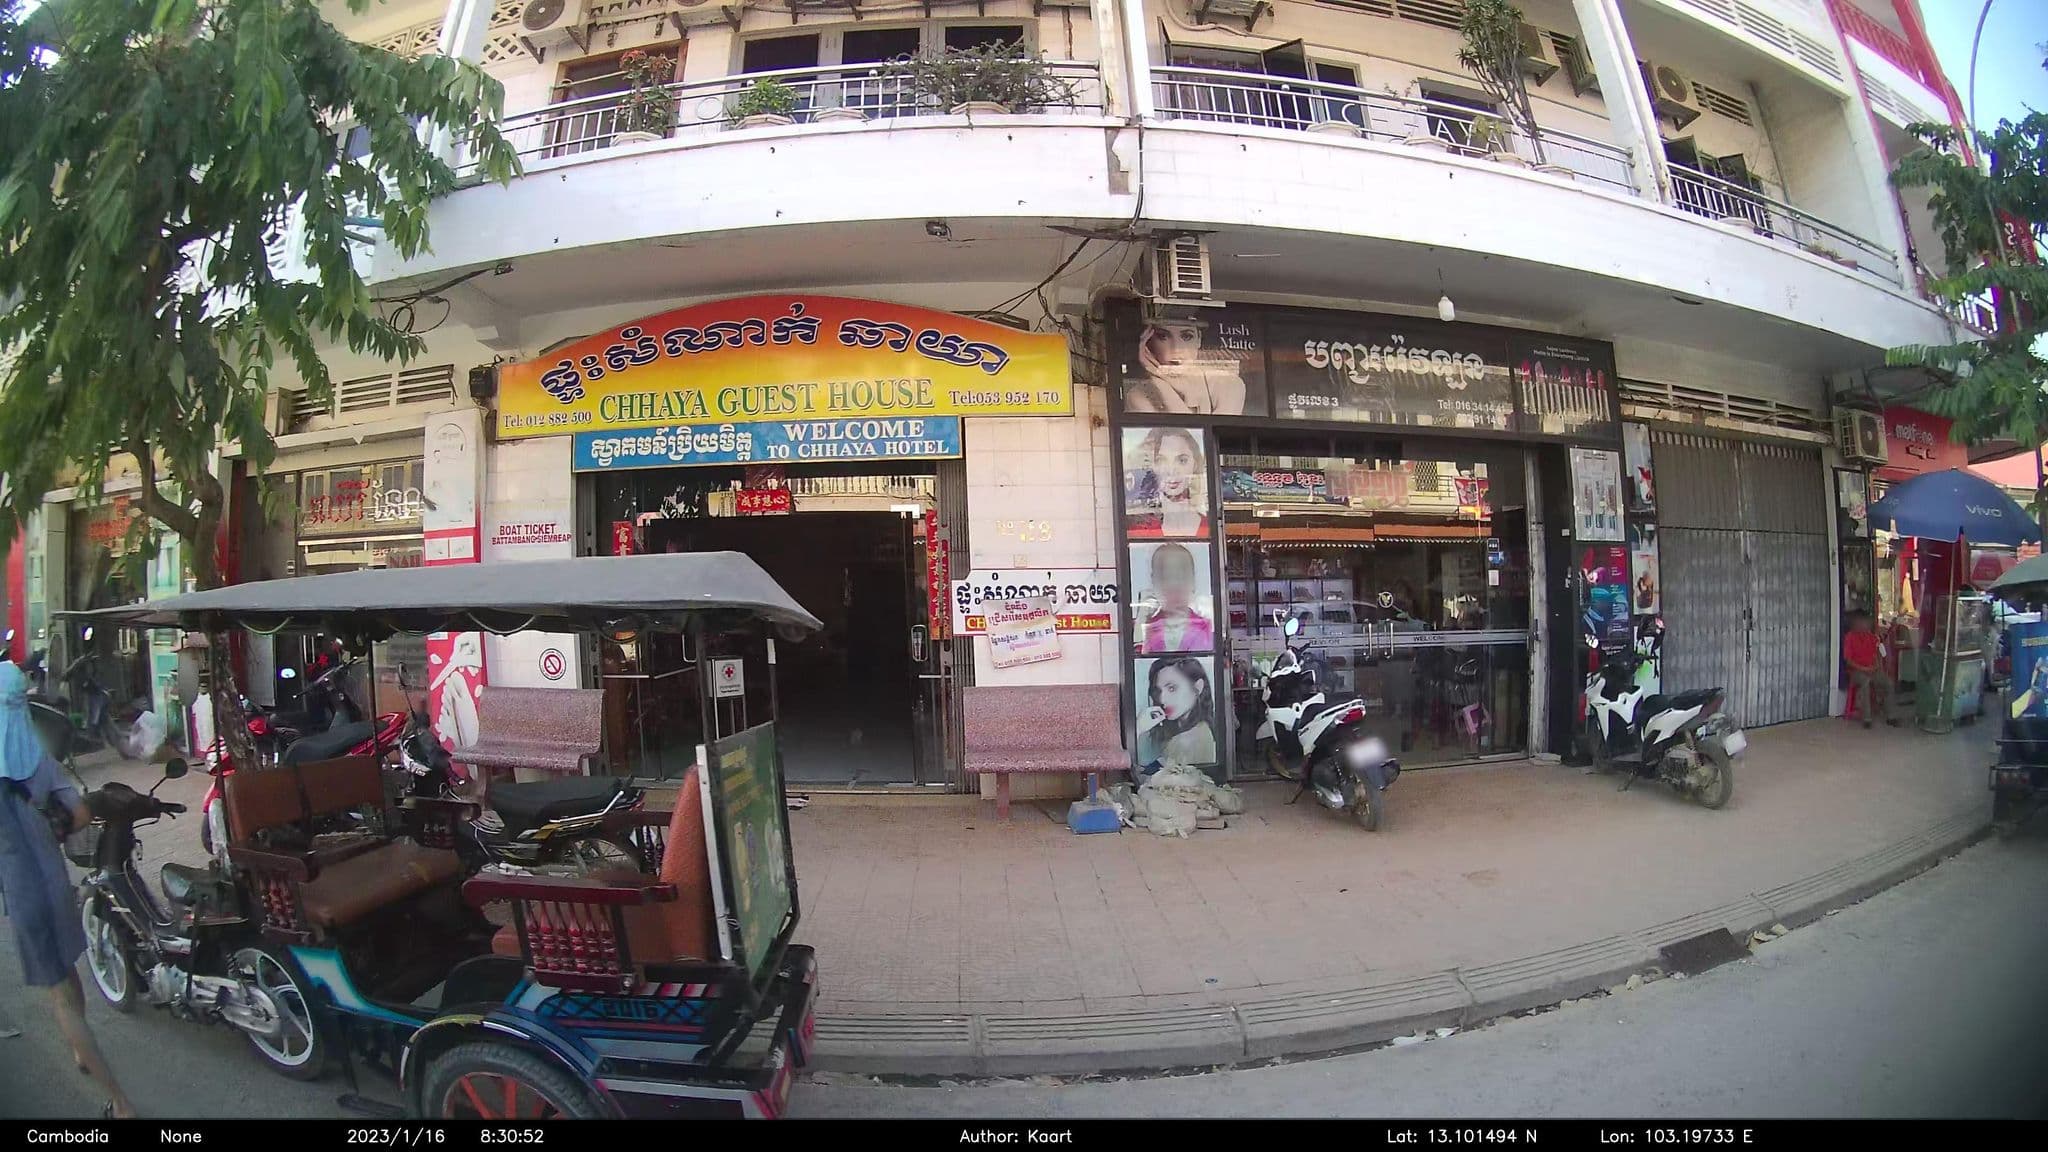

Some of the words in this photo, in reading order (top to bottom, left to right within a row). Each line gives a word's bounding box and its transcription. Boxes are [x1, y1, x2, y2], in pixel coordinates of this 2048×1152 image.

[1218, 323, 1250, 336] Lush
[1220, 336, 1256, 350] Matte
[540, 303, 822, 404] ផ្ទះសំណាក់
[838, 318, 1009, 375] ឆាយា
[600, 389, 709, 423] CHHAYA
[717, 383, 818, 415] GUEST
[827, 378, 935, 412] HOUSE
[1005, 391, 1029, 405] 952
[1035, 391, 1059, 404] 170
[503, 415, 523, 429] Tel:
[525, 416, 545, 427] 012
[548, 413, 568, 425] 882
[571, 411, 592, 424] 500
[783, 419, 925, 441] WELCOME
[591, 424, 752, 466] ស្វាគមន៍ប្រិយមិត្ត
[767, 443, 790, 459] TO
[798, 442, 877, 458] CHHAYA
[885, 440, 949, 456] HOTEL
[1965, 504, 2002, 517] vivo
[500, 525, 522, 536] BOAT
[524, 523, 556, 535] TICKET
